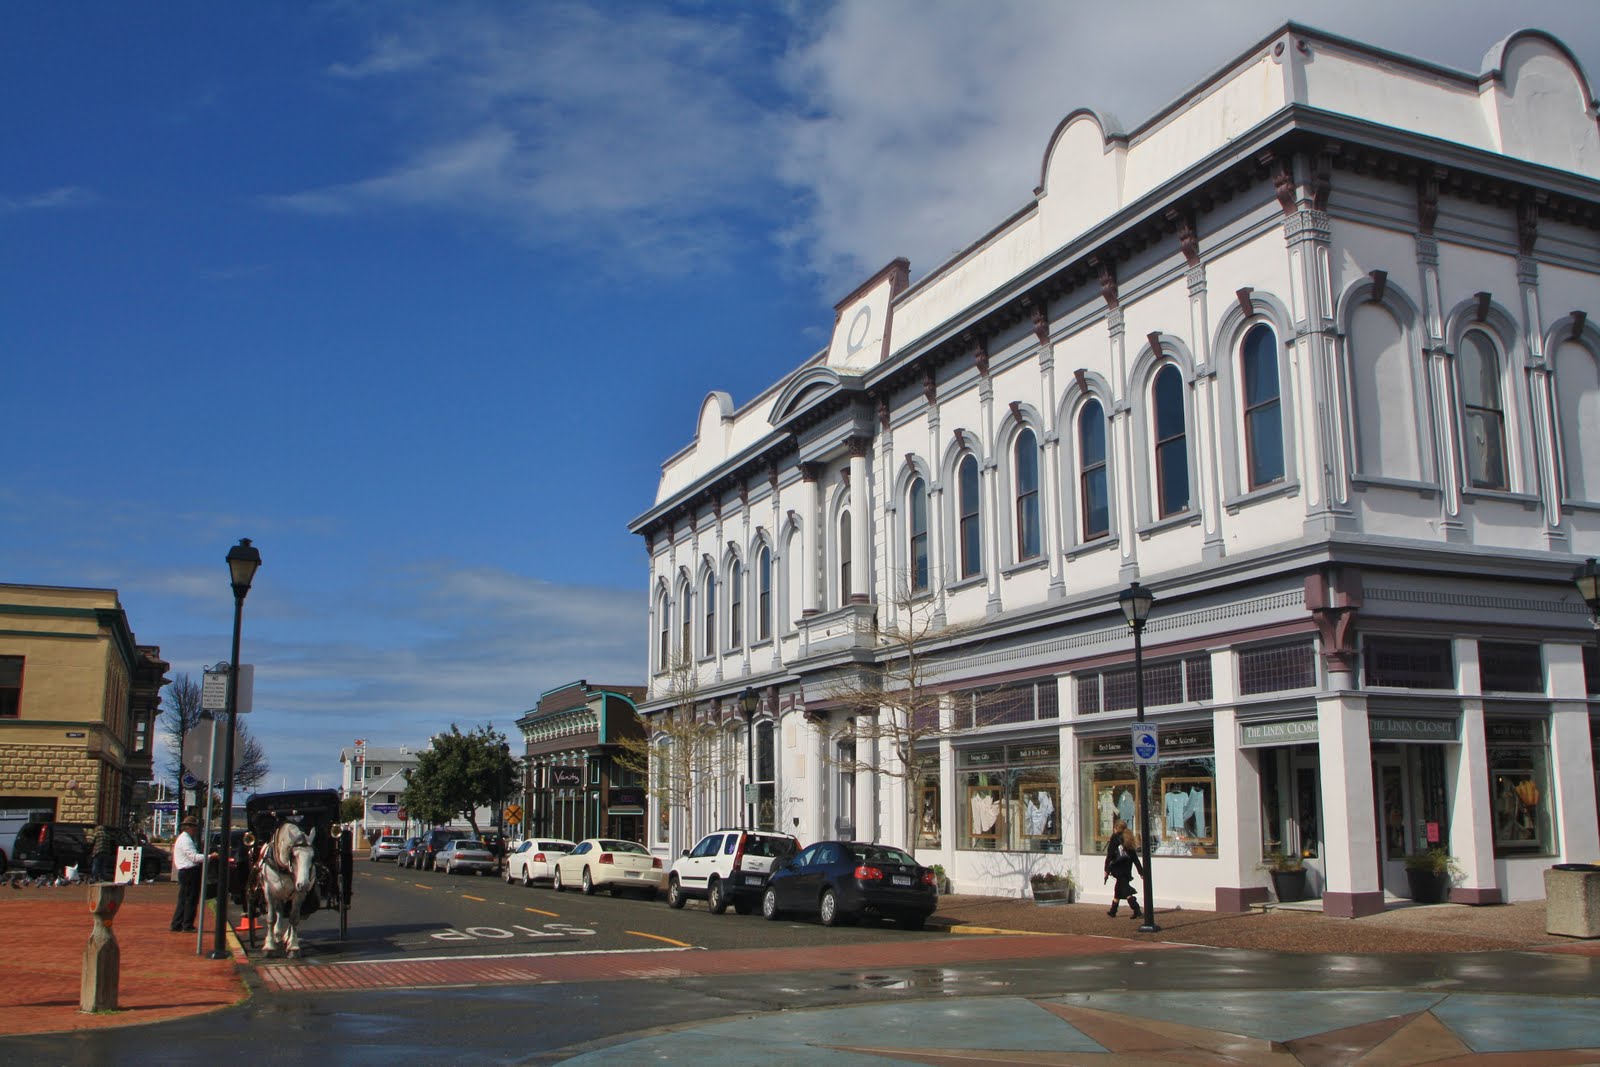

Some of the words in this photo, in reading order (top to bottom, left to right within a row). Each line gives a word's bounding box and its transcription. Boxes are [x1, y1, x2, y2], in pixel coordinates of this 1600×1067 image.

[1247, 727, 1261, 738] THE
[1263, 725, 1285, 736] LINEN
[1287, 722, 1319, 735] CLOSE
[1388, 719, 1412, 731] LINEN
[1415, 719, 1453, 732] CLOSET
[554, 771, 580, 784] Vanity
[430, 923, 597, 940] STOP
